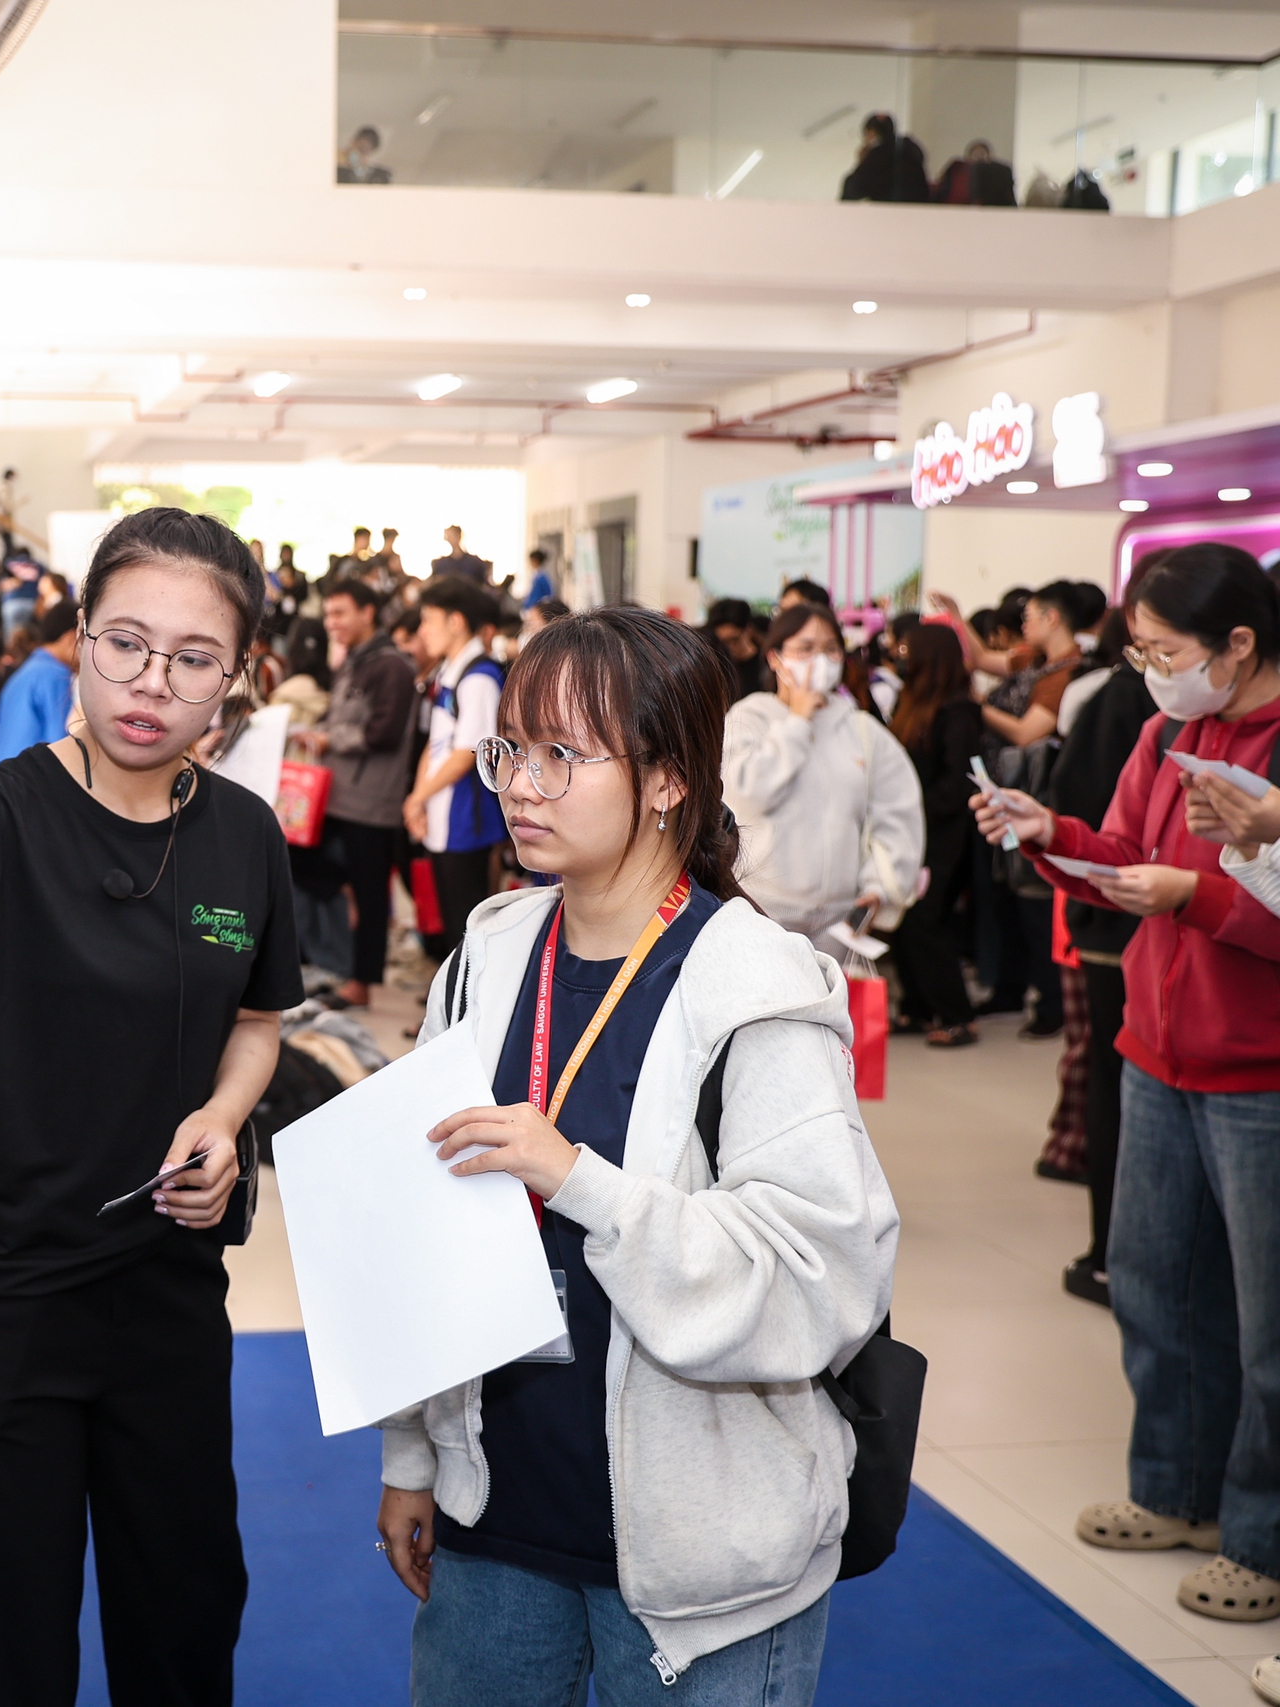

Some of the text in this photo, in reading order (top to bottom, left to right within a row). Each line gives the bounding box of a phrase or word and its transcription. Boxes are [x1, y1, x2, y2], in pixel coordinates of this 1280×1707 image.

[540, 946, 553, 998] UNIVERSITY
[536, 999, 546, 1034] SAIGON
[535, 1042, 544, 1062] LAW
[533, 1064, 543, 1077] OF
[532, 1079, 542, 1109] CULTY
[549, 1101, 559, 1123] HOA
